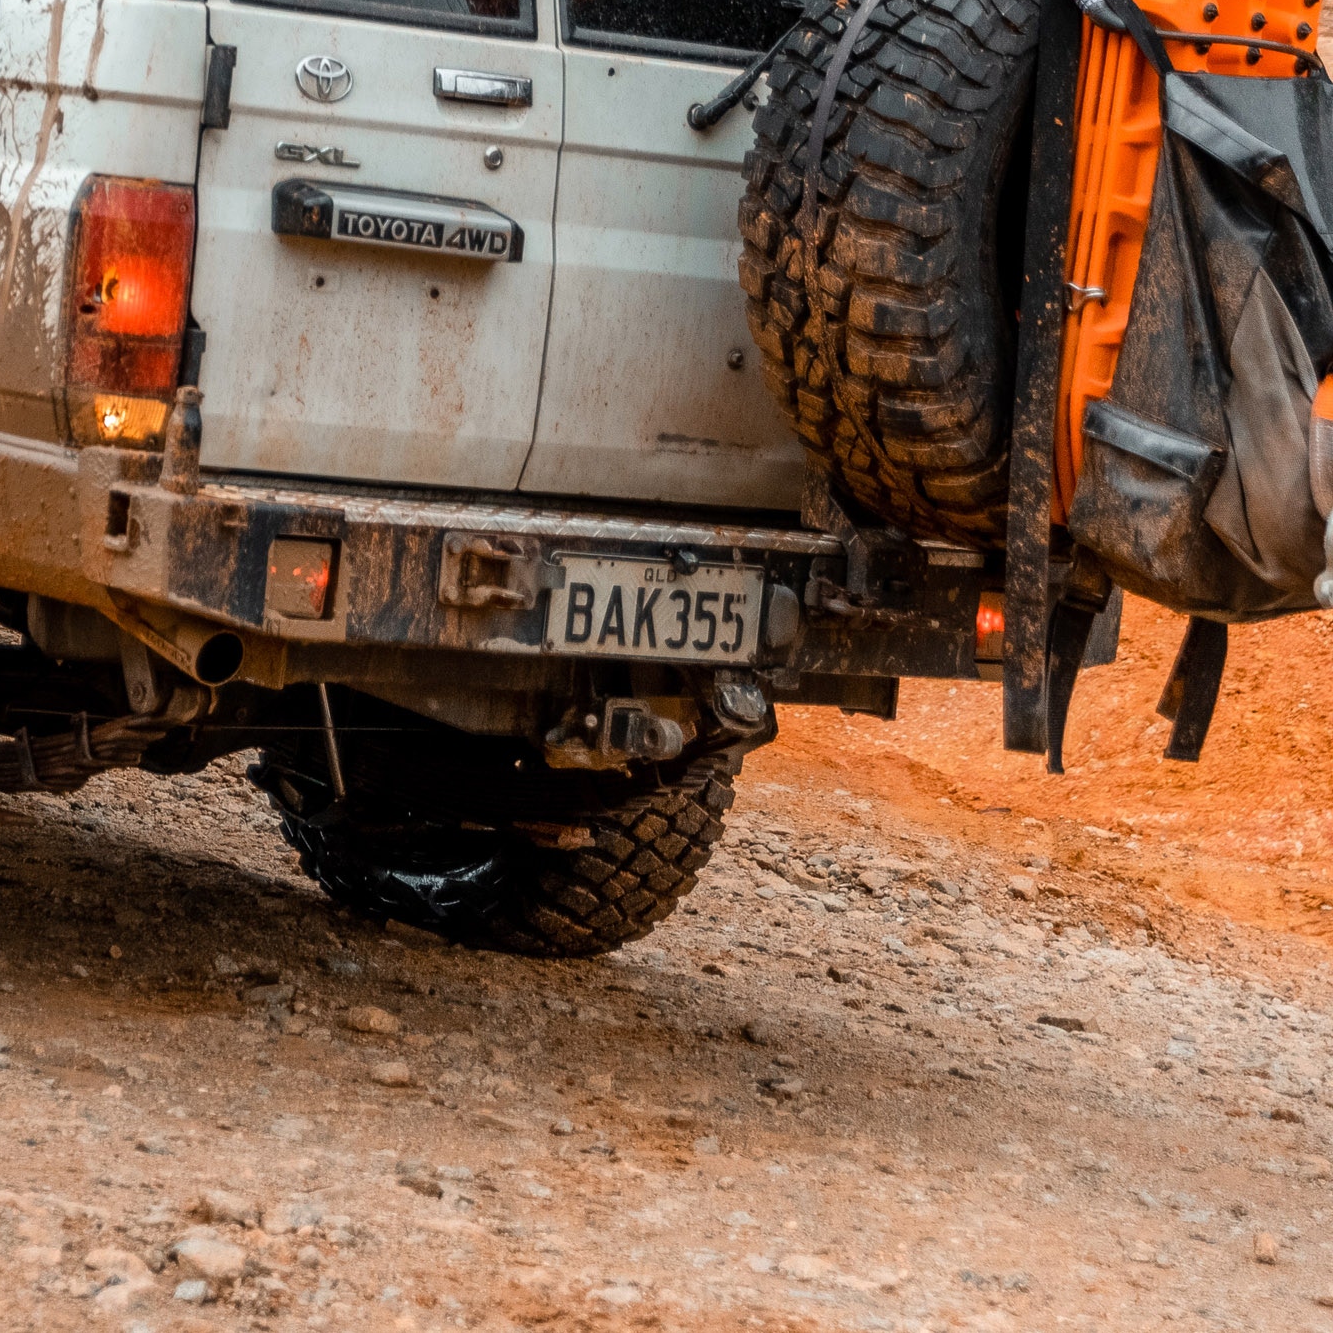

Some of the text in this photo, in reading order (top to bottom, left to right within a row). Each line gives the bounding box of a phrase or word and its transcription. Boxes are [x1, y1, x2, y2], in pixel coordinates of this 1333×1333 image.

[275, 140, 361, 168] GXL
[344, 213, 509, 256] TOYOTA 4WD
[644, 566, 677, 583] QLD
[564, 581, 745, 653] BAK355
